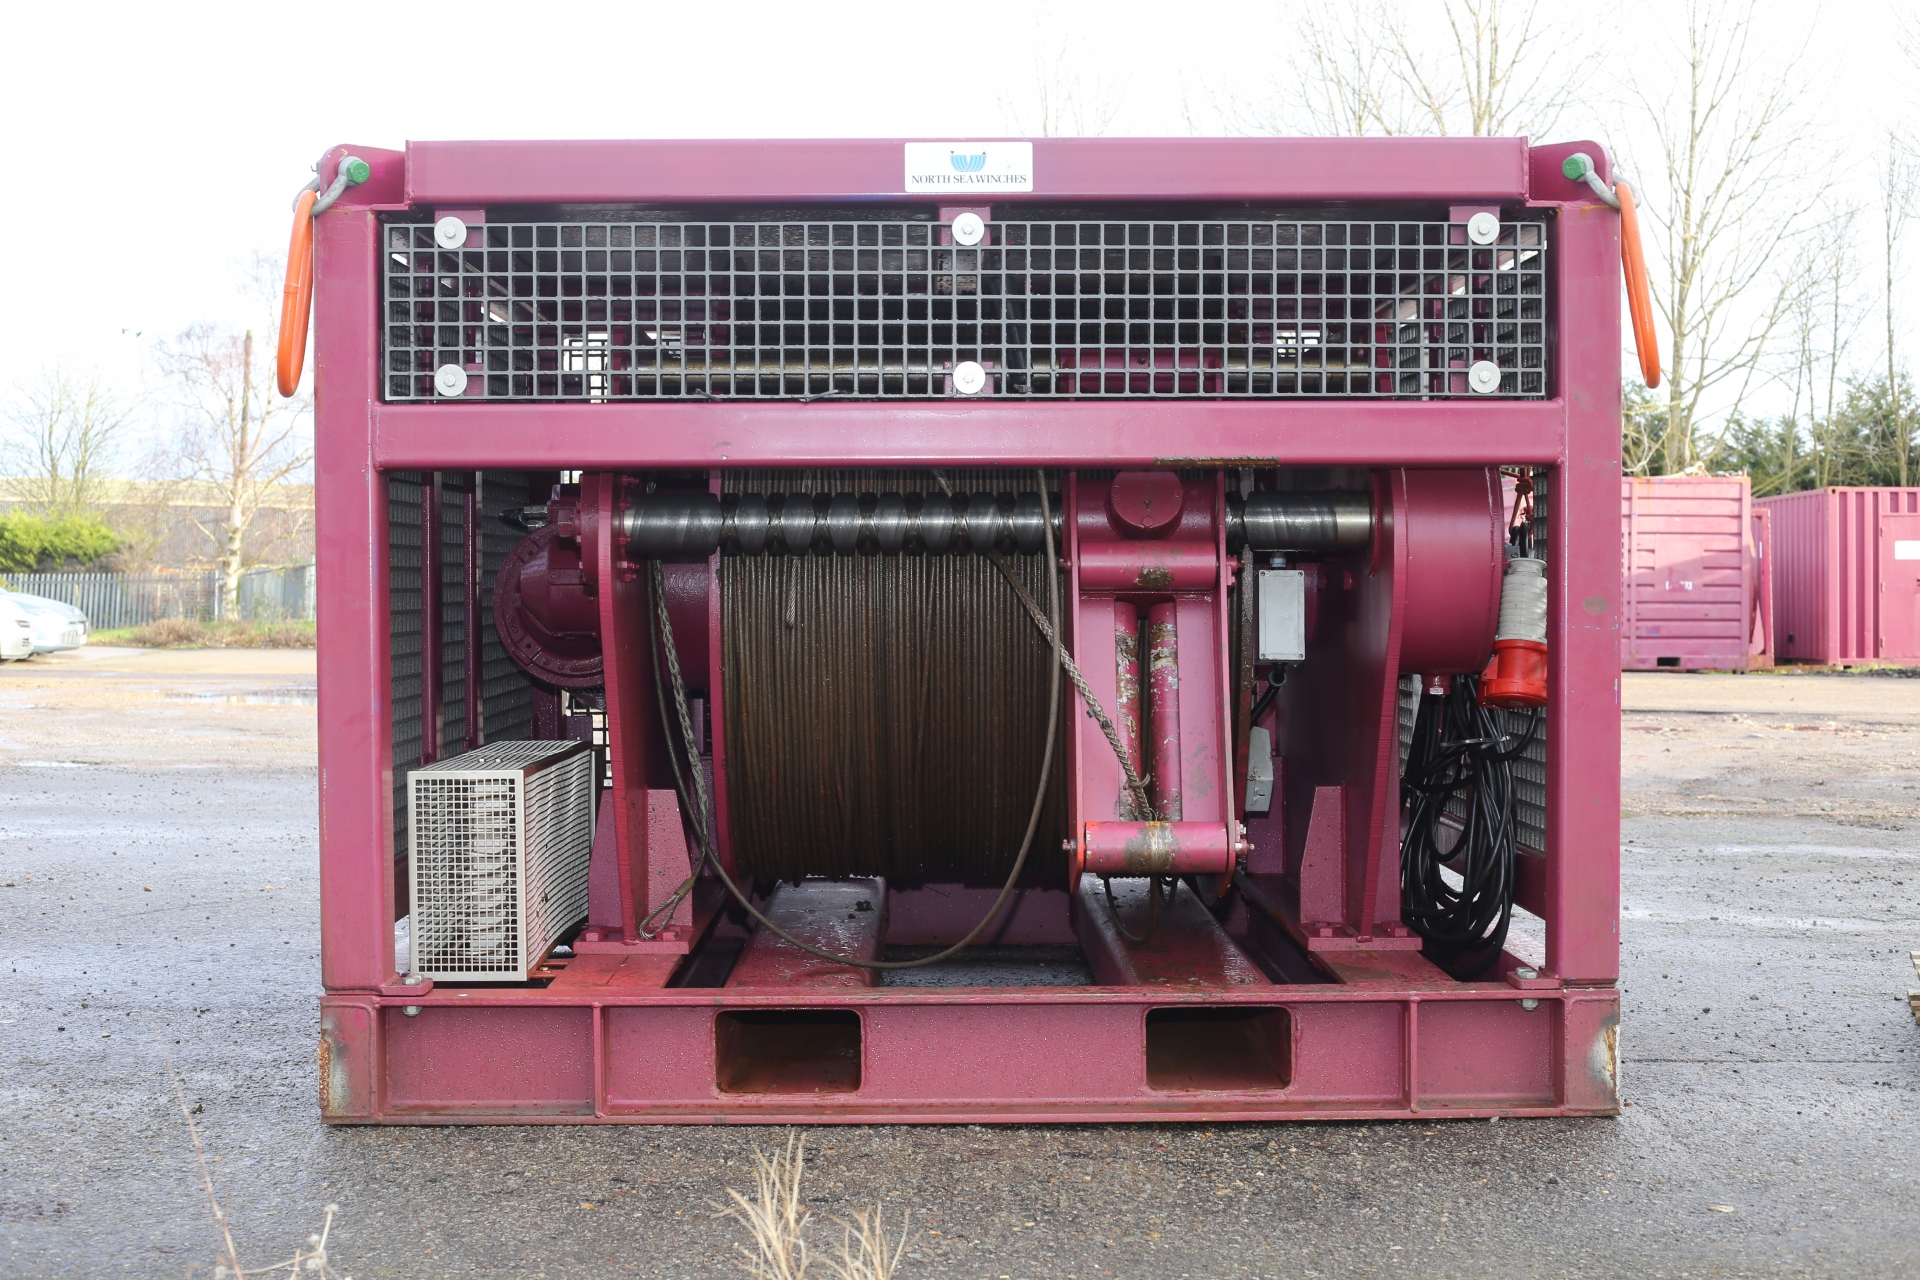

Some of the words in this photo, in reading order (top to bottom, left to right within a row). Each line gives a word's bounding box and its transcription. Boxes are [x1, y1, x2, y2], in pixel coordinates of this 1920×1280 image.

[911, 175, 951, 184] NORTH
[953, 175, 974, 184] SEA
[975, 174, 1027, 184] WINCHES
